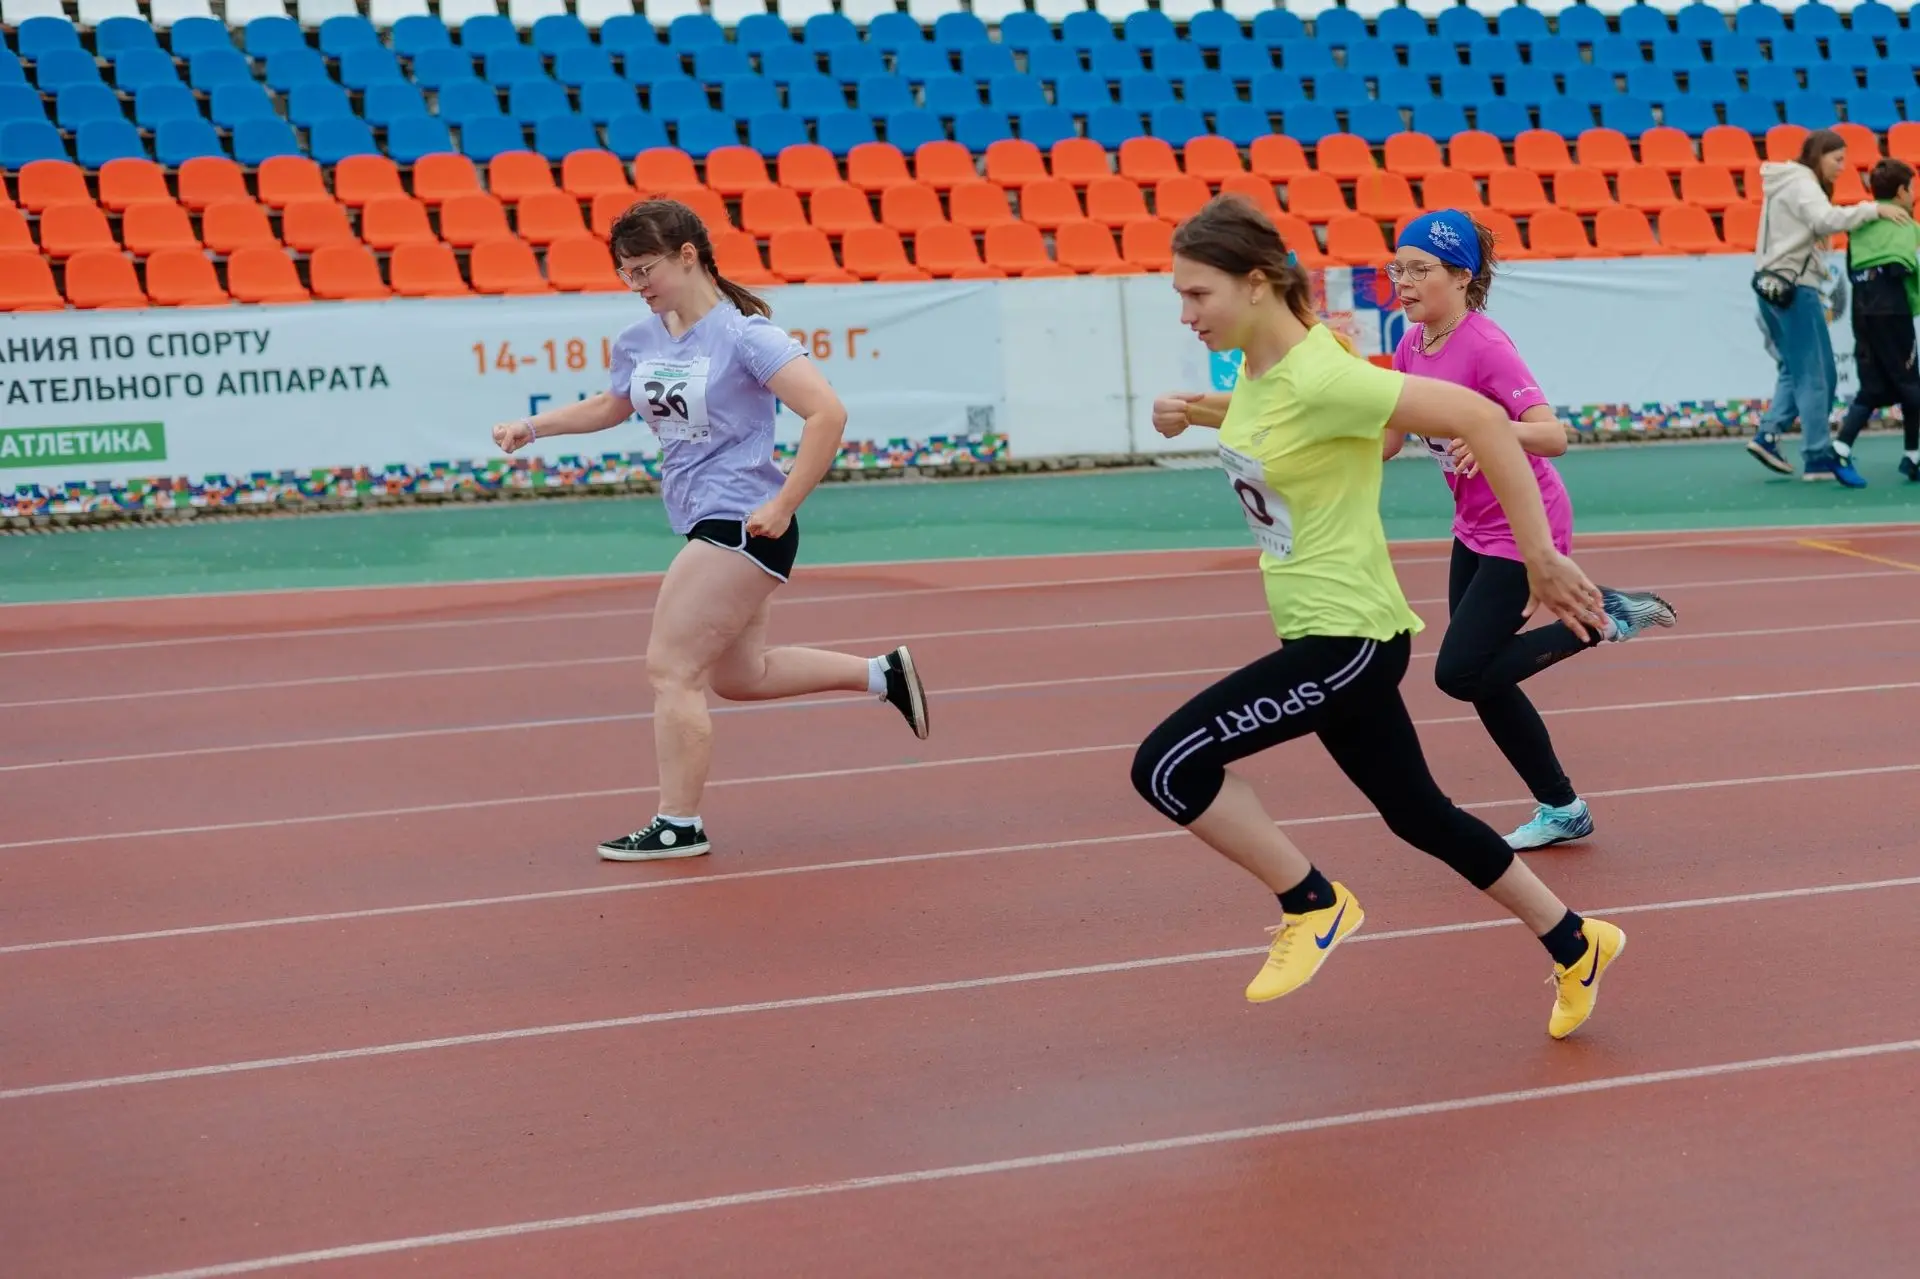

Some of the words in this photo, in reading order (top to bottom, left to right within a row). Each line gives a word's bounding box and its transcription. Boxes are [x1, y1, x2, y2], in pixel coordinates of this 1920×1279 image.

[0, 337, 79, 363] НИЯ
[89, 335, 134, 360] ПО
[147, 330, 270, 357] СПОРТУ
[0, 373, 204, 404] АТЕЛЬНОГО
[216, 365, 390, 396] АППАРАТА
[644, 381, 689, 421] 36
[0, 428, 152, 458] АТЛЕТИКА
[1215, 681, 1326, 742] SPORT
